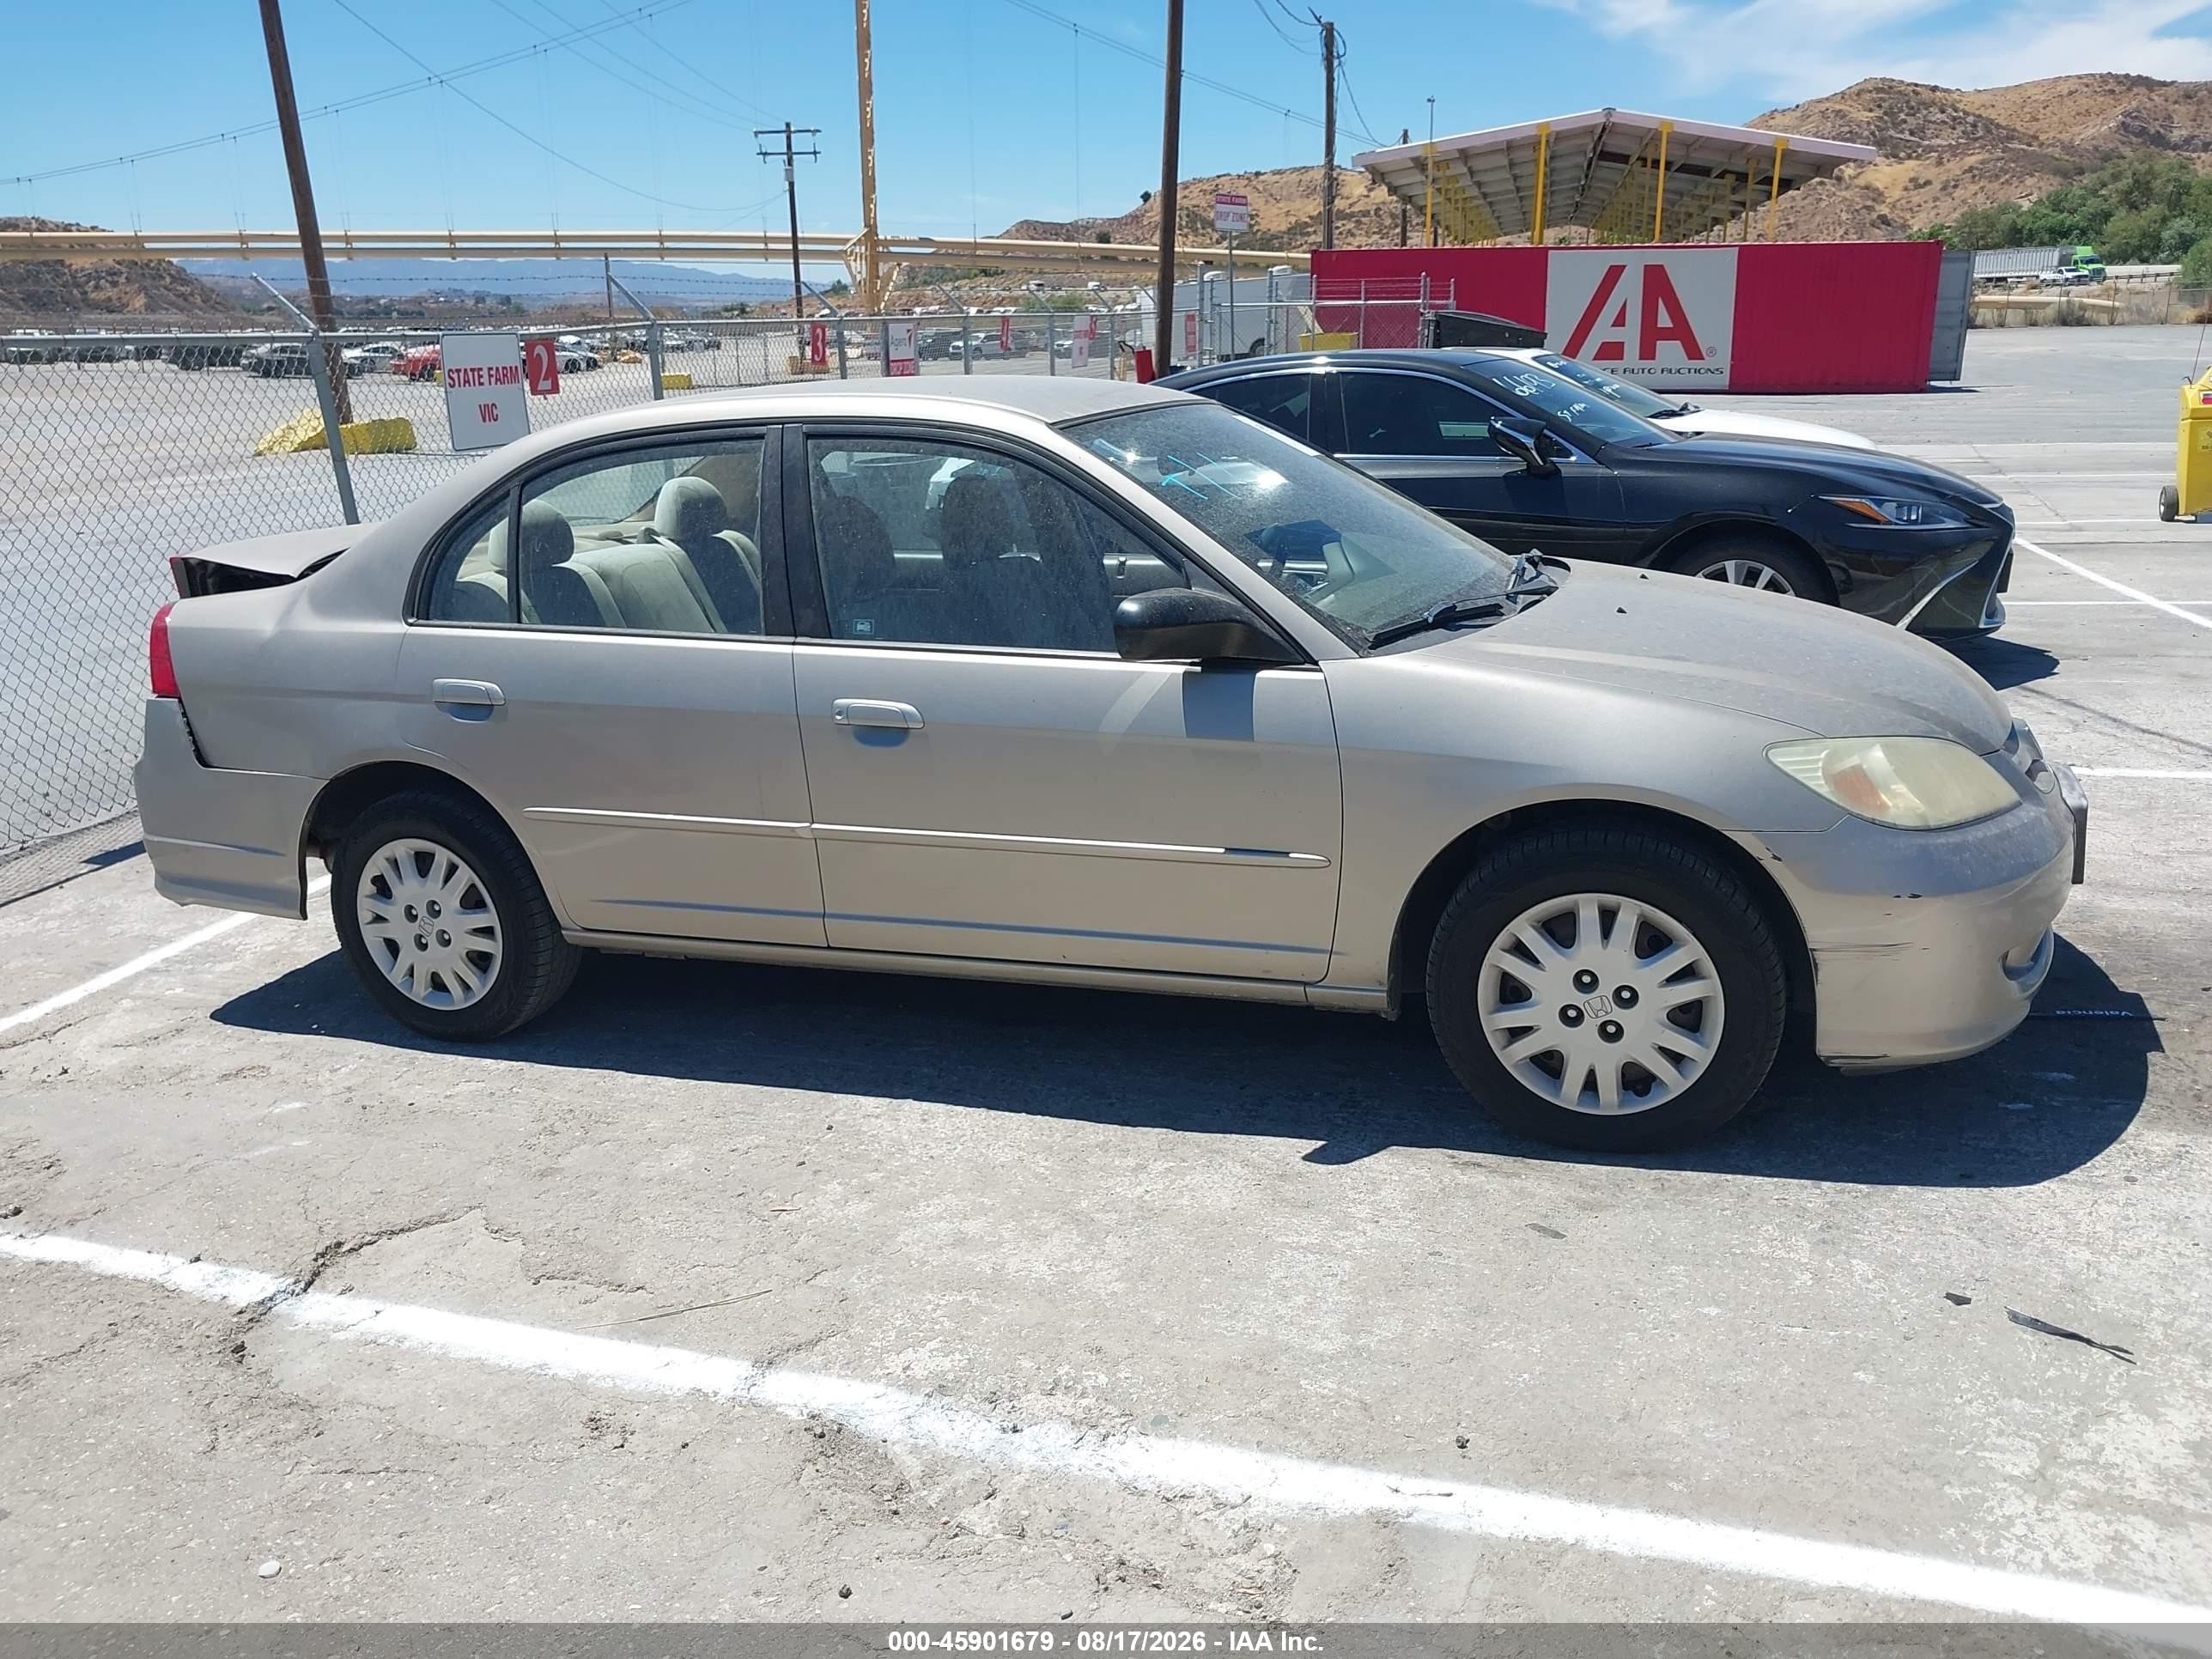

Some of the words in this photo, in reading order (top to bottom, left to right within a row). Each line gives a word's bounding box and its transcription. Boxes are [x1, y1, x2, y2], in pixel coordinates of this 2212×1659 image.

[814, 327, 823, 362] 3
[447, 368, 485, 389] STATE
[487, 366, 520, 386] FARM
[533, 344, 552, 391] 2
[478, 403, 499, 423] VIC
